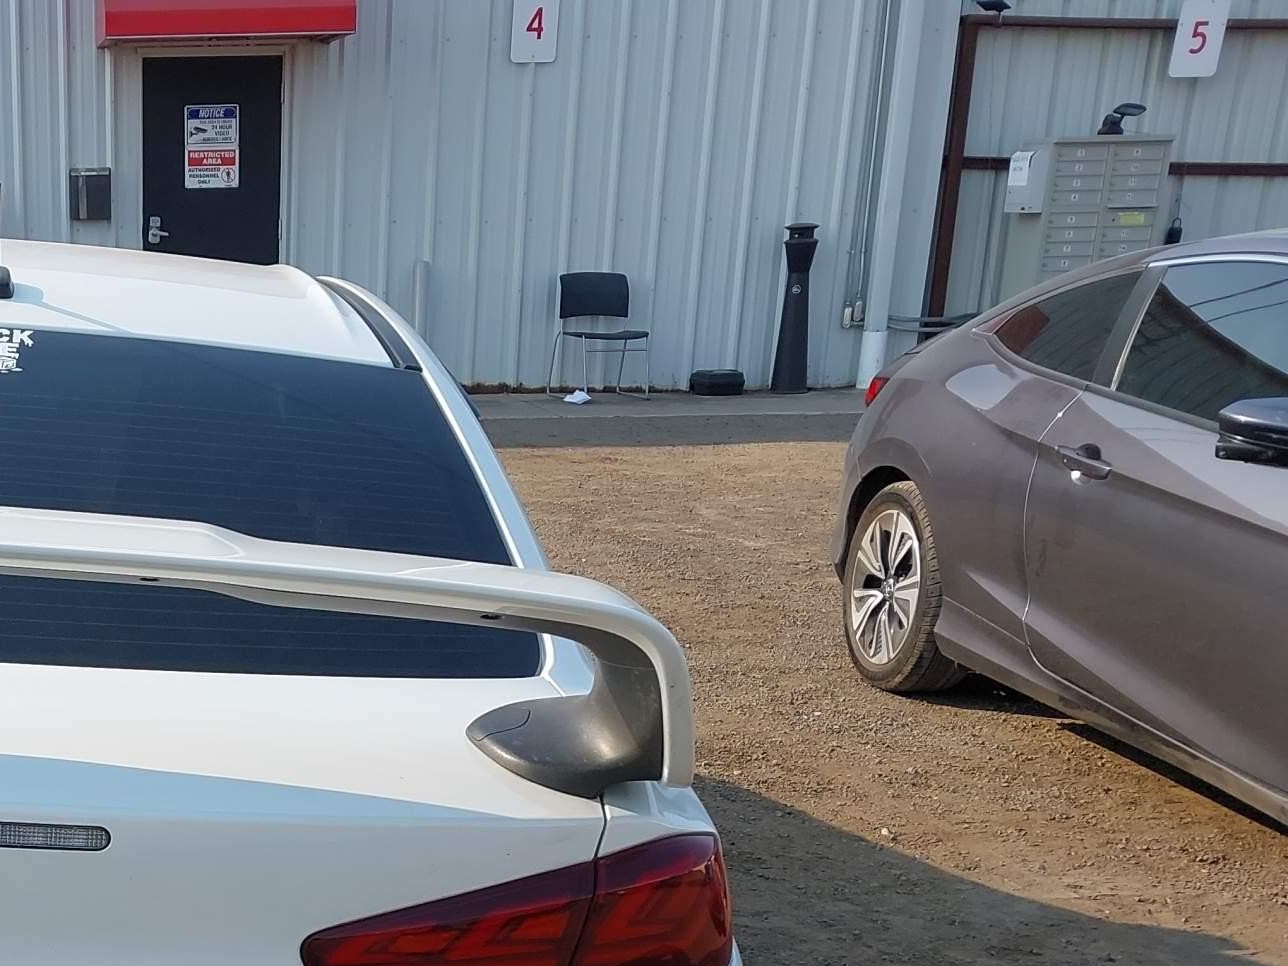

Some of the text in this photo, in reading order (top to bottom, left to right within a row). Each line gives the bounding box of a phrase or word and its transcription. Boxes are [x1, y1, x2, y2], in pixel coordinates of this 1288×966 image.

[526, 6, 544, 40] 4
[1188, 21, 1209, 54] 5
[199, 109, 225, 118] NOTICE
